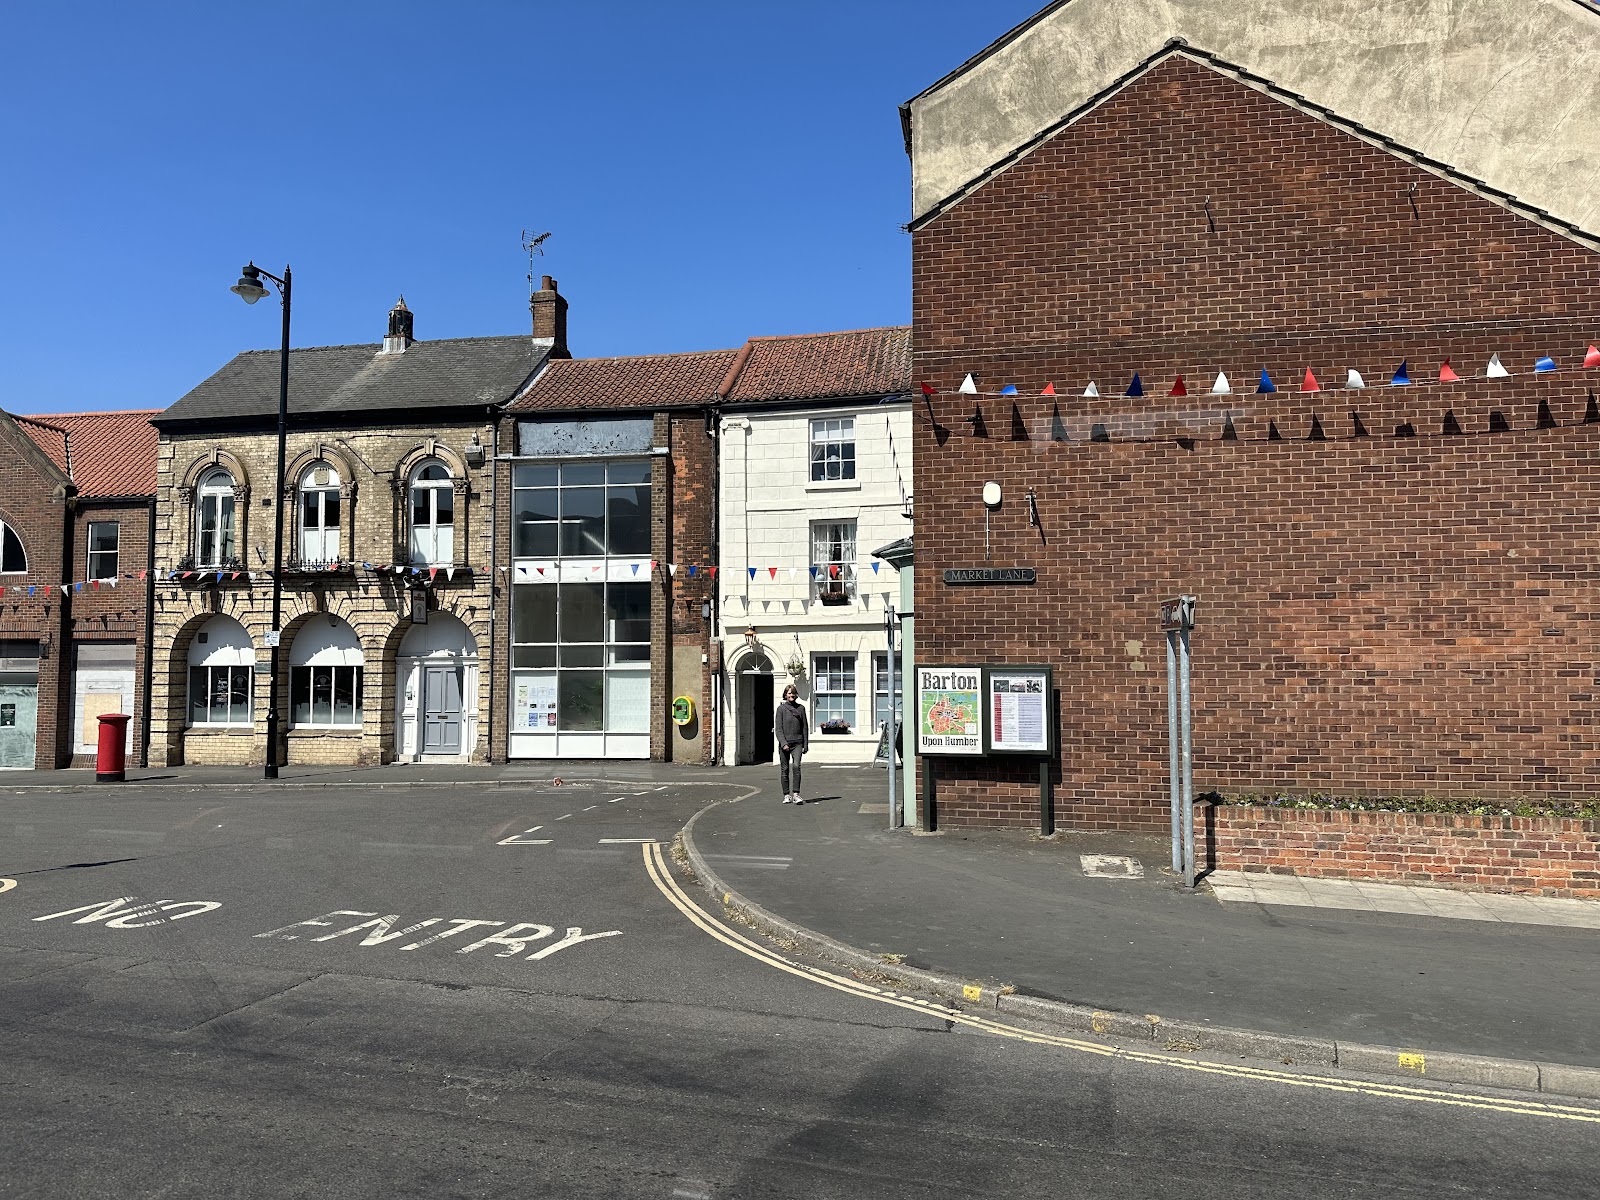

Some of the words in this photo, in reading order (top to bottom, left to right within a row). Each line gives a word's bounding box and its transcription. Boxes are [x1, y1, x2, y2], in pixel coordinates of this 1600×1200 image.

[951, 569, 996, 580] MARKET
[999, 569, 1028, 580] LANE
[921, 671, 978, 690] Barton
[922, 736, 943, 747] Upon
[945, 736, 979, 747] Humber
[31, 896, 223, 929] NO
[252, 909, 624, 961] ENTRY
